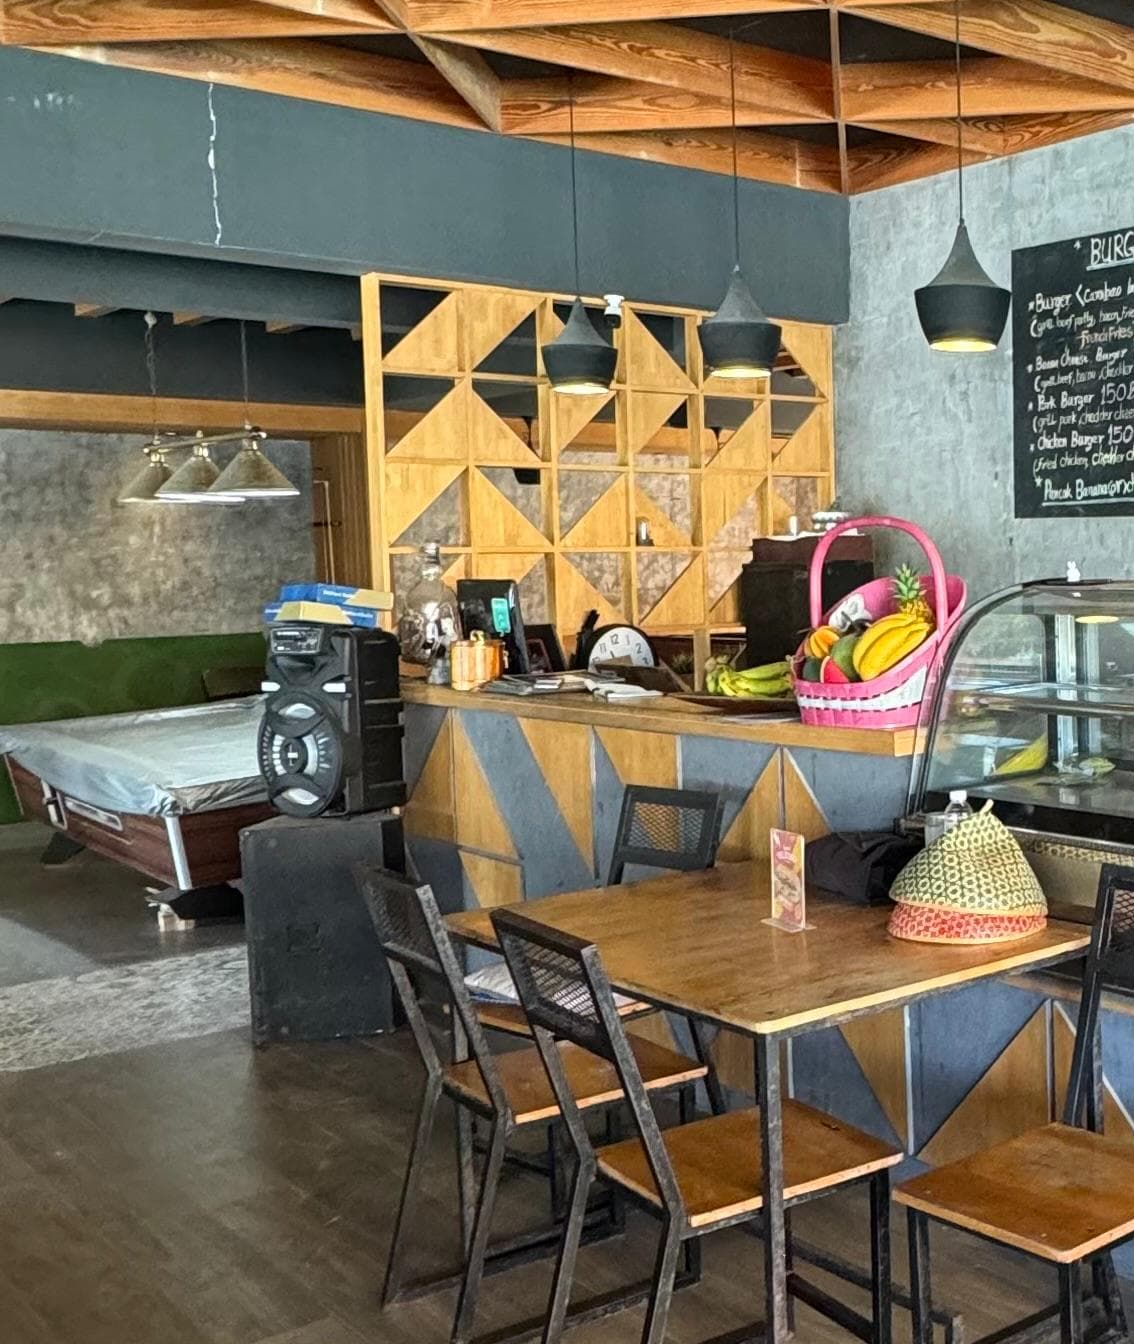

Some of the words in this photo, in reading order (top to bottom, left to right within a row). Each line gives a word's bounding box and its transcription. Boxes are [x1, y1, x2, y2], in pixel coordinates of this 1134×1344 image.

[1035, 293, 1073, 316] Burger
[1061, 391, 1094, 411] Burger
[1070, 429, 1104, 452] Burger
